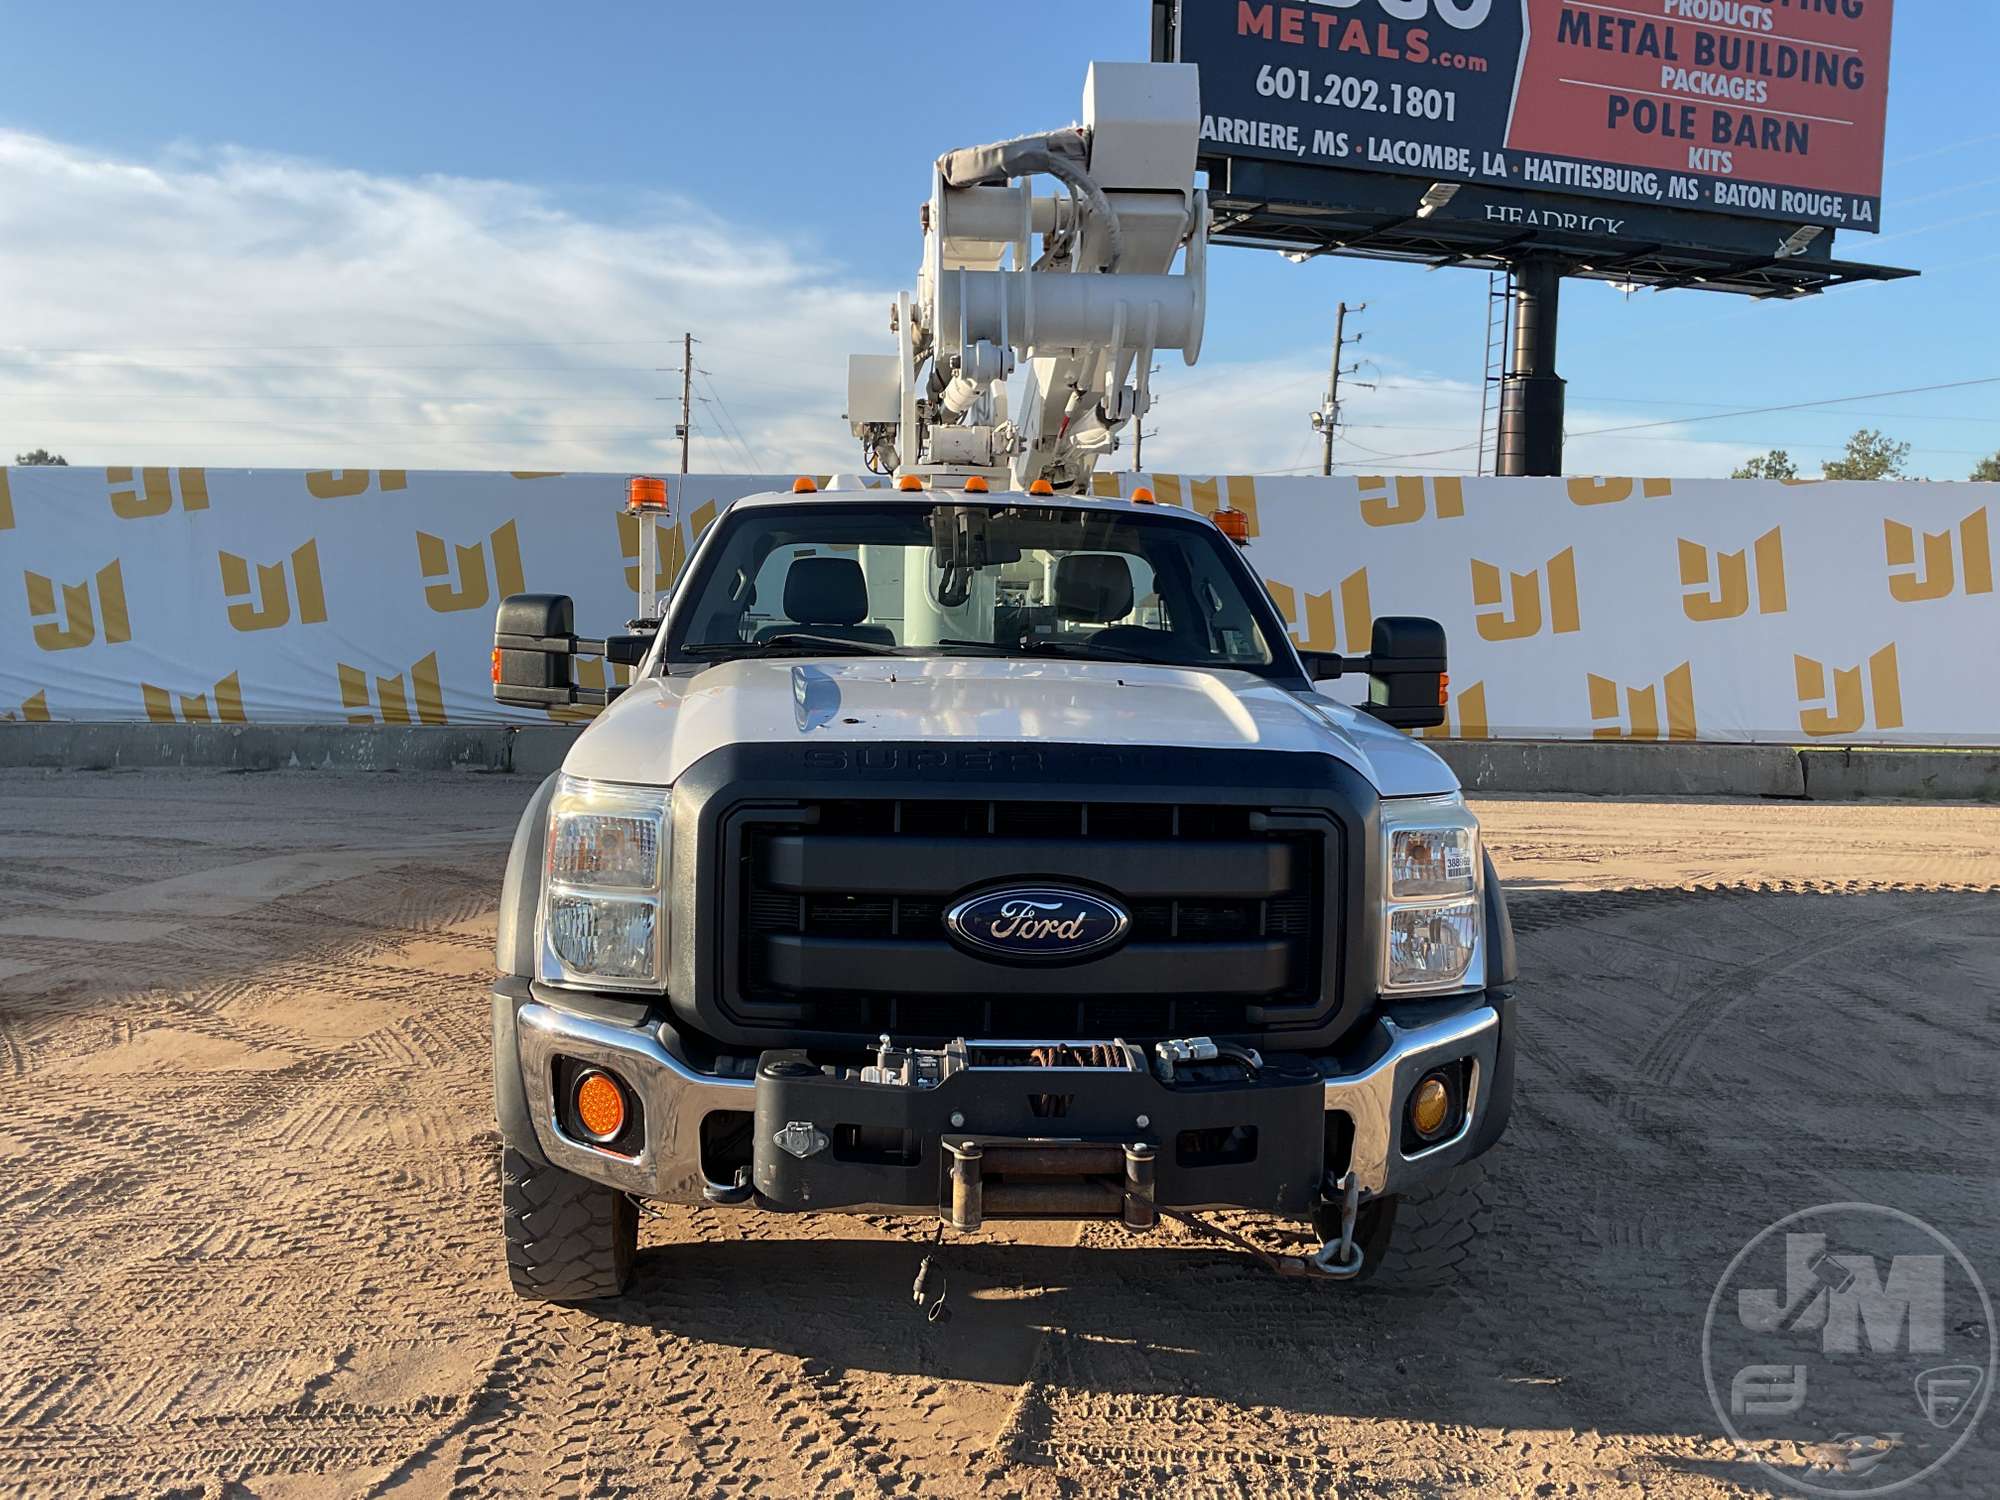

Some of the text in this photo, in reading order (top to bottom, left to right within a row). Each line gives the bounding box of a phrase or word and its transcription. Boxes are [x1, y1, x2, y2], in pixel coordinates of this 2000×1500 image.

[1557, 8, 1679, 62] METAL
[1693, 32, 1865, 90] BUILDING
[1256, 65, 1456, 122] 601.202.1801
[1661, 65, 1768, 104] PACKAGES
[1607, 95, 1809, 156] POLE BARN
[1200, 115, 1873, 223] ARRIERE, MS LACOMBE, LA HATTIESBURG, MS BATON ROUGE, LA
[1688, 146, 1734, 174] KITS
[1484, 204, 1625, 234] HEADRICK
[991, 900, 1086, 939] Ford
